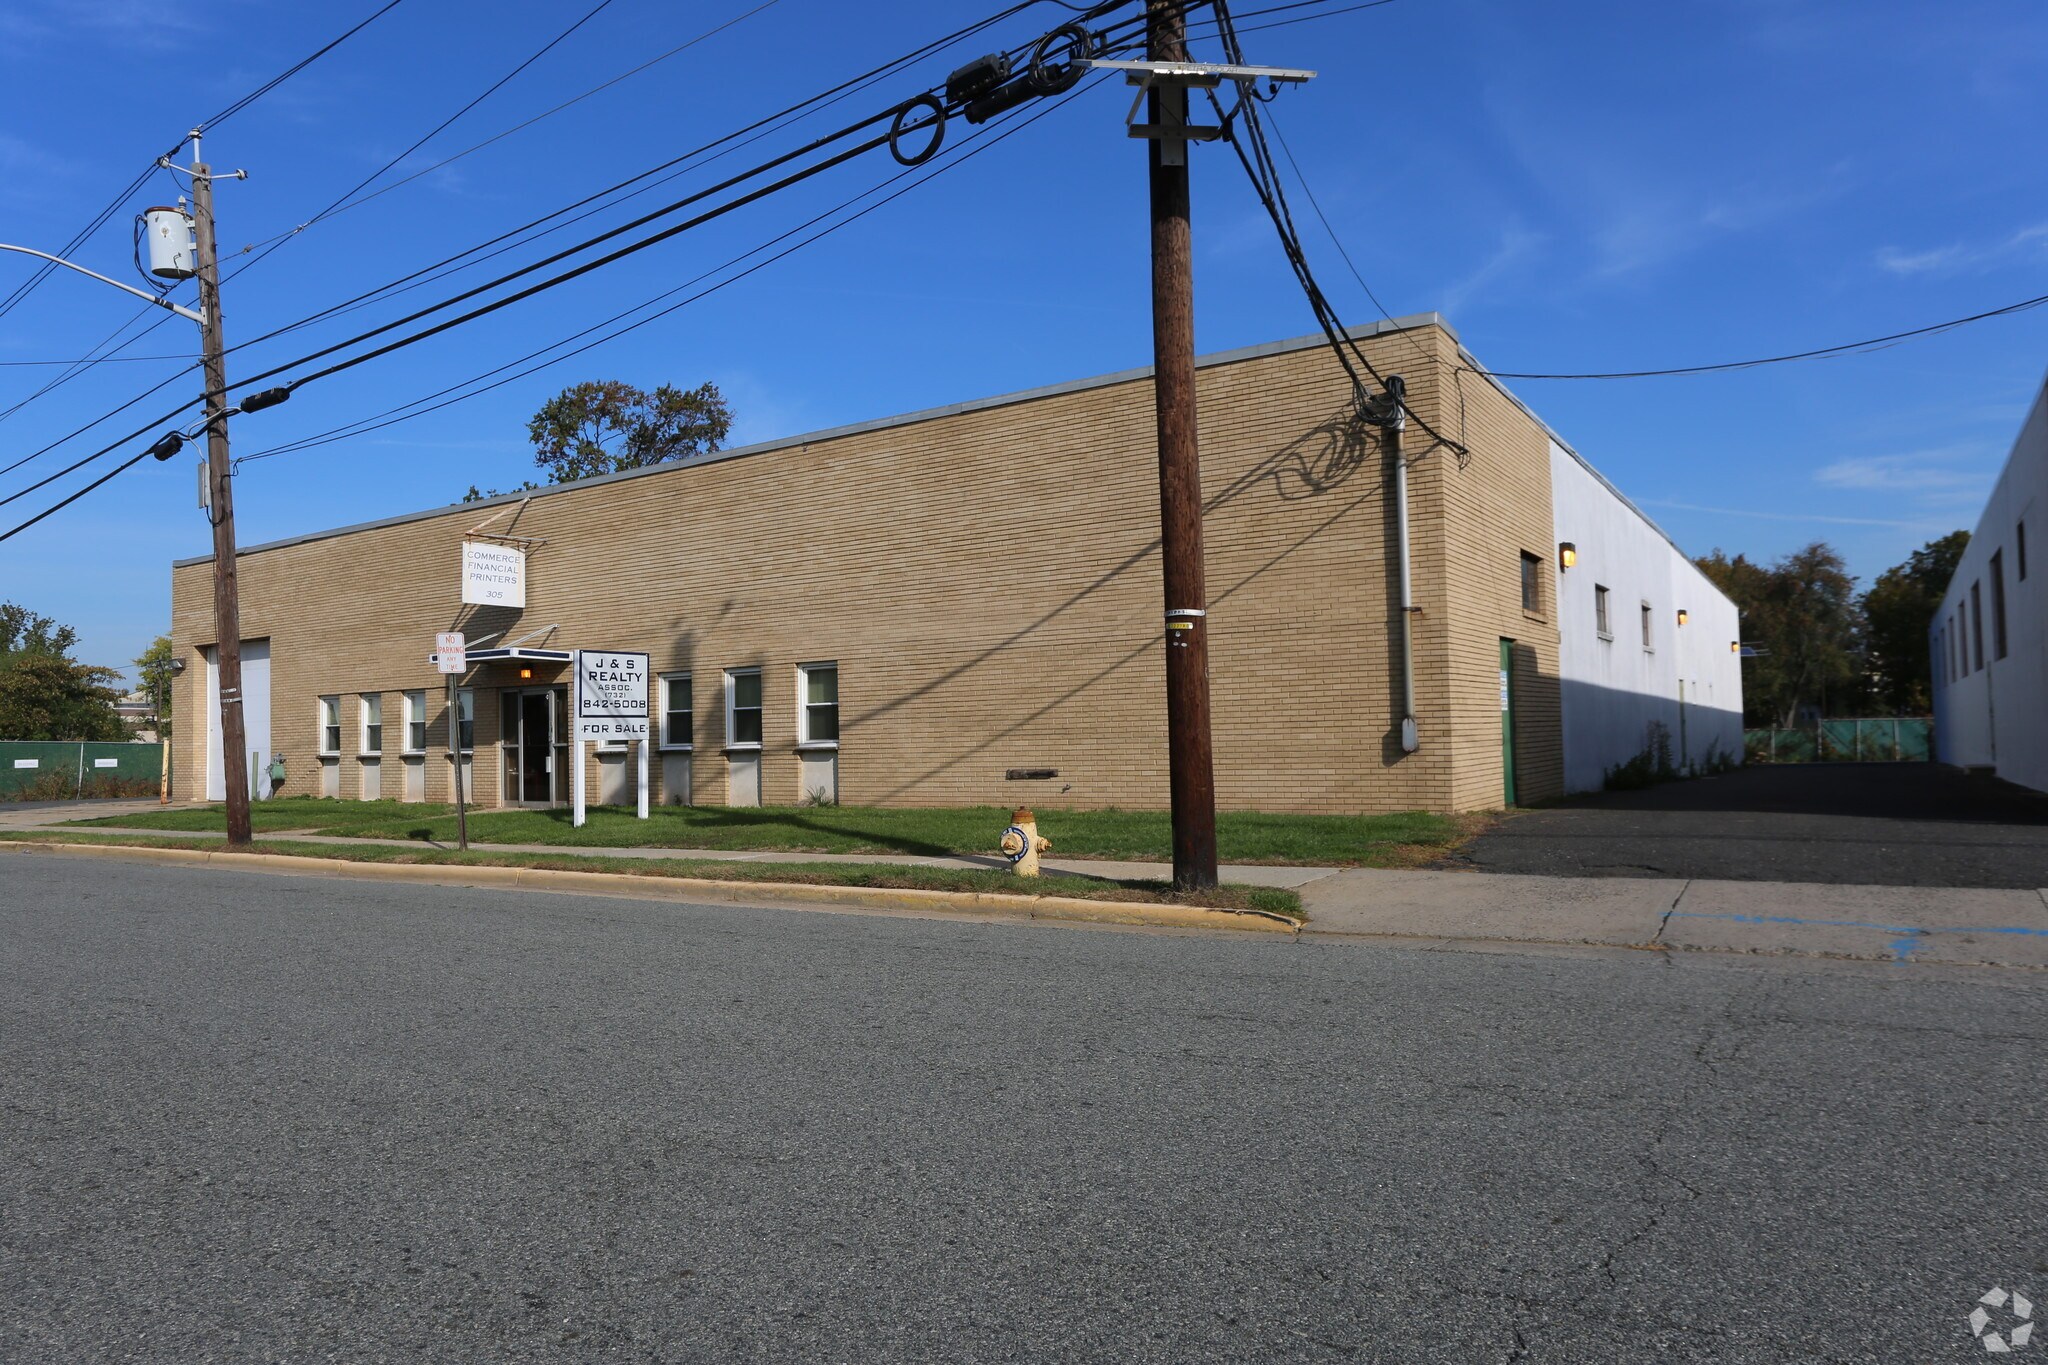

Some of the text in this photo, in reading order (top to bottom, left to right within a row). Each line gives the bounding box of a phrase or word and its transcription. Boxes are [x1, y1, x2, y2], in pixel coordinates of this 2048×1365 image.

[467, 551, 520, 563] COMMERCE
[468, 562, 518, 574] FINANCIAL
[470, 573, 517, 584] PRINTERS
[438, 646, 464, 654] PARKING
[596, 659, 634, 669] J & S
[589, 671, 642, 682] REALTY
[584, 699, 646, 708] 842-5008
[584, 724, 646, 733] FOR SALE
